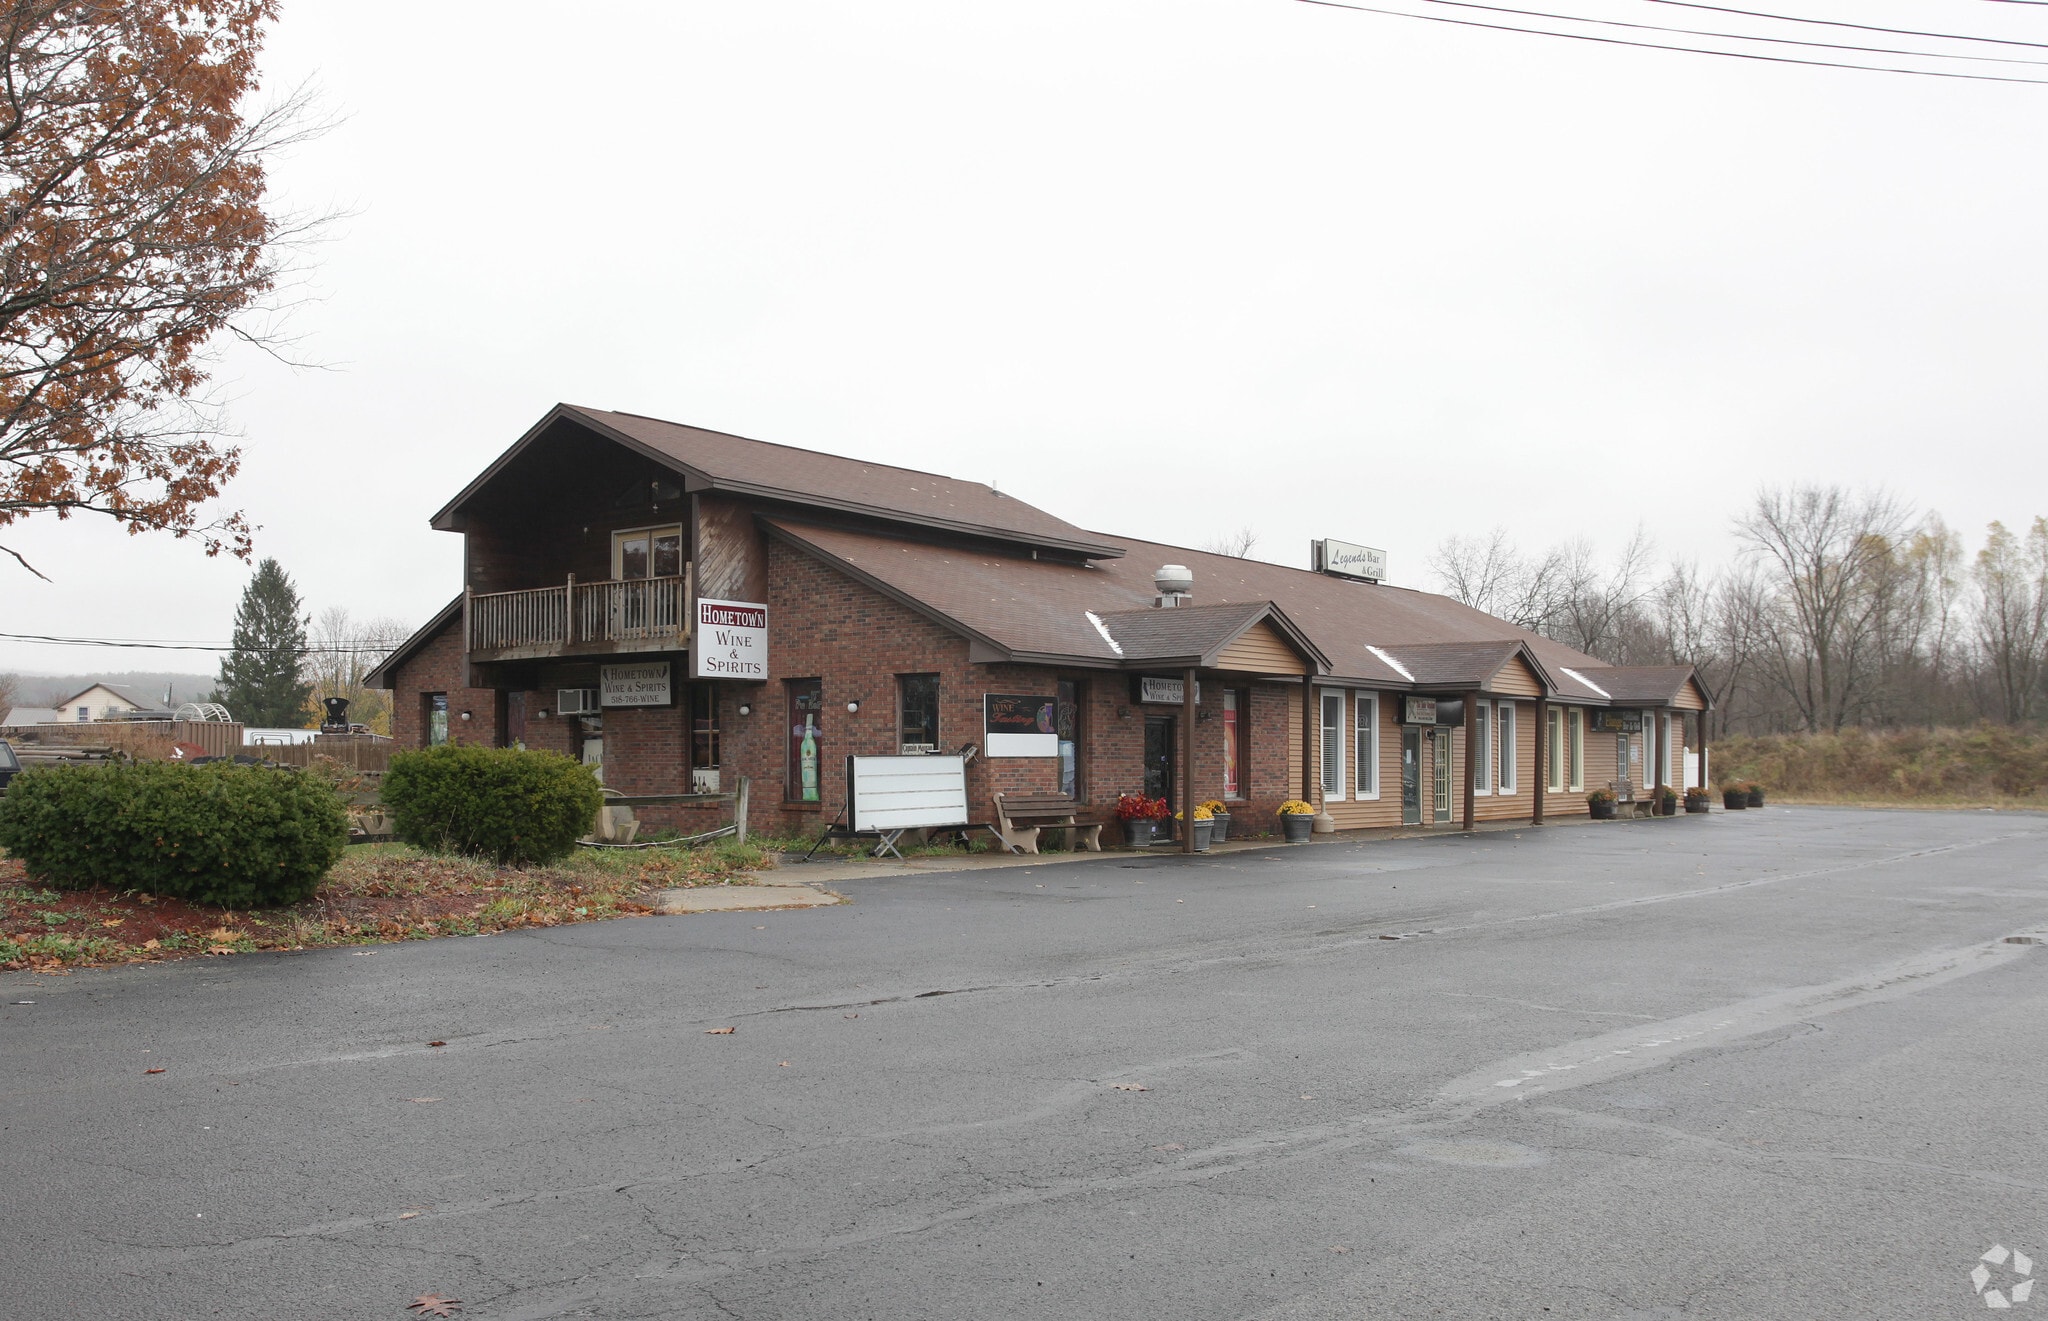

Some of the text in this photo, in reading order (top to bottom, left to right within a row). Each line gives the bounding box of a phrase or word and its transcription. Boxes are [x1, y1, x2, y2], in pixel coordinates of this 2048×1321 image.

[1331, 549, 1380, 568] Legends Bar
[1366, 565, 1384, 578] Grill
[702, 604, 764, 627] HOMETOWN
[715, 630, 752, 648] WINE
[729, 648, 739, 659] &
[706, 656, 761, 674] SPIRITS
[610, 668, 661, 681] HOMETOWN
[604, 681, 667, 693] WINE & SPIRITS
[1149, 679, 1184, 691] HOMETO
[610, 694, 660, 704] 518-766-WINE
[992, 703, 1015, 712] WINE
[989, 712, 1035, 727] Tasting
